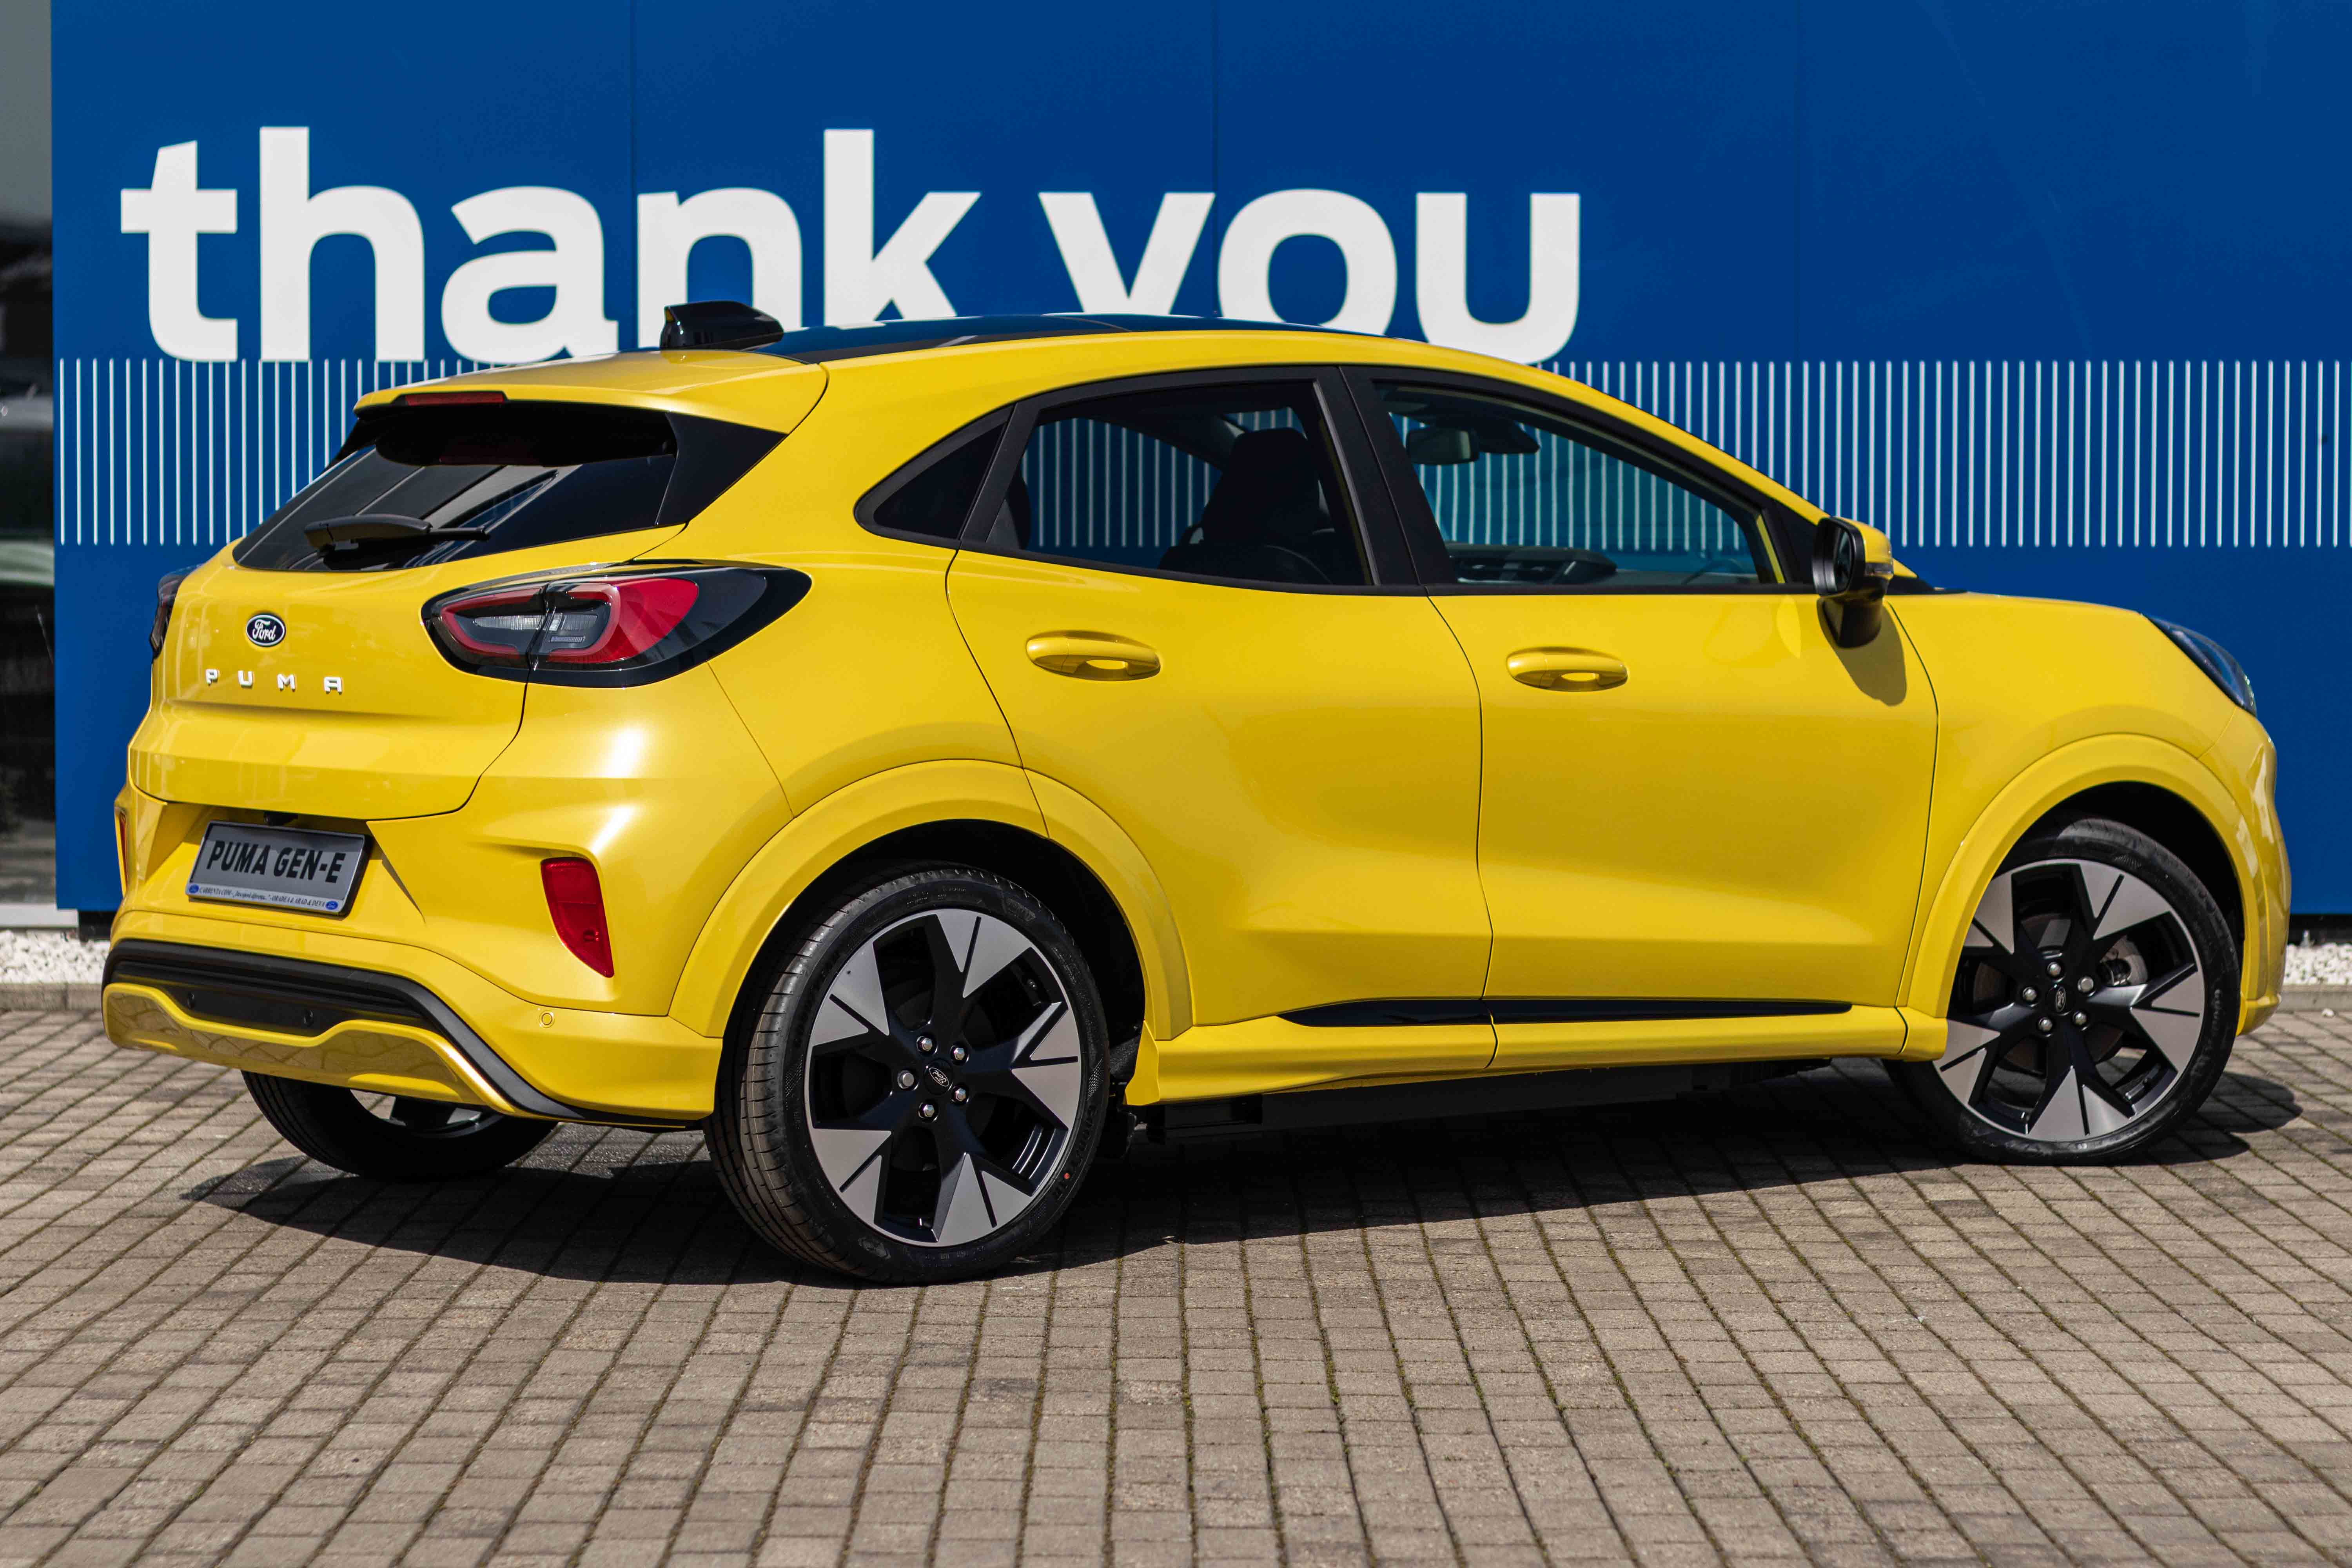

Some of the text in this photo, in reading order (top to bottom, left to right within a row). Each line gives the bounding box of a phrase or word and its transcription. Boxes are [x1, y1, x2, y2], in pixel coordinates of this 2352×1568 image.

[121, 127, 1580, 365] thank you
[205, 668, 343, 694] PUMA
[206, 840, 346, 883] PUMA GEN-E
[932, 1070, 947, 1084] Ford
